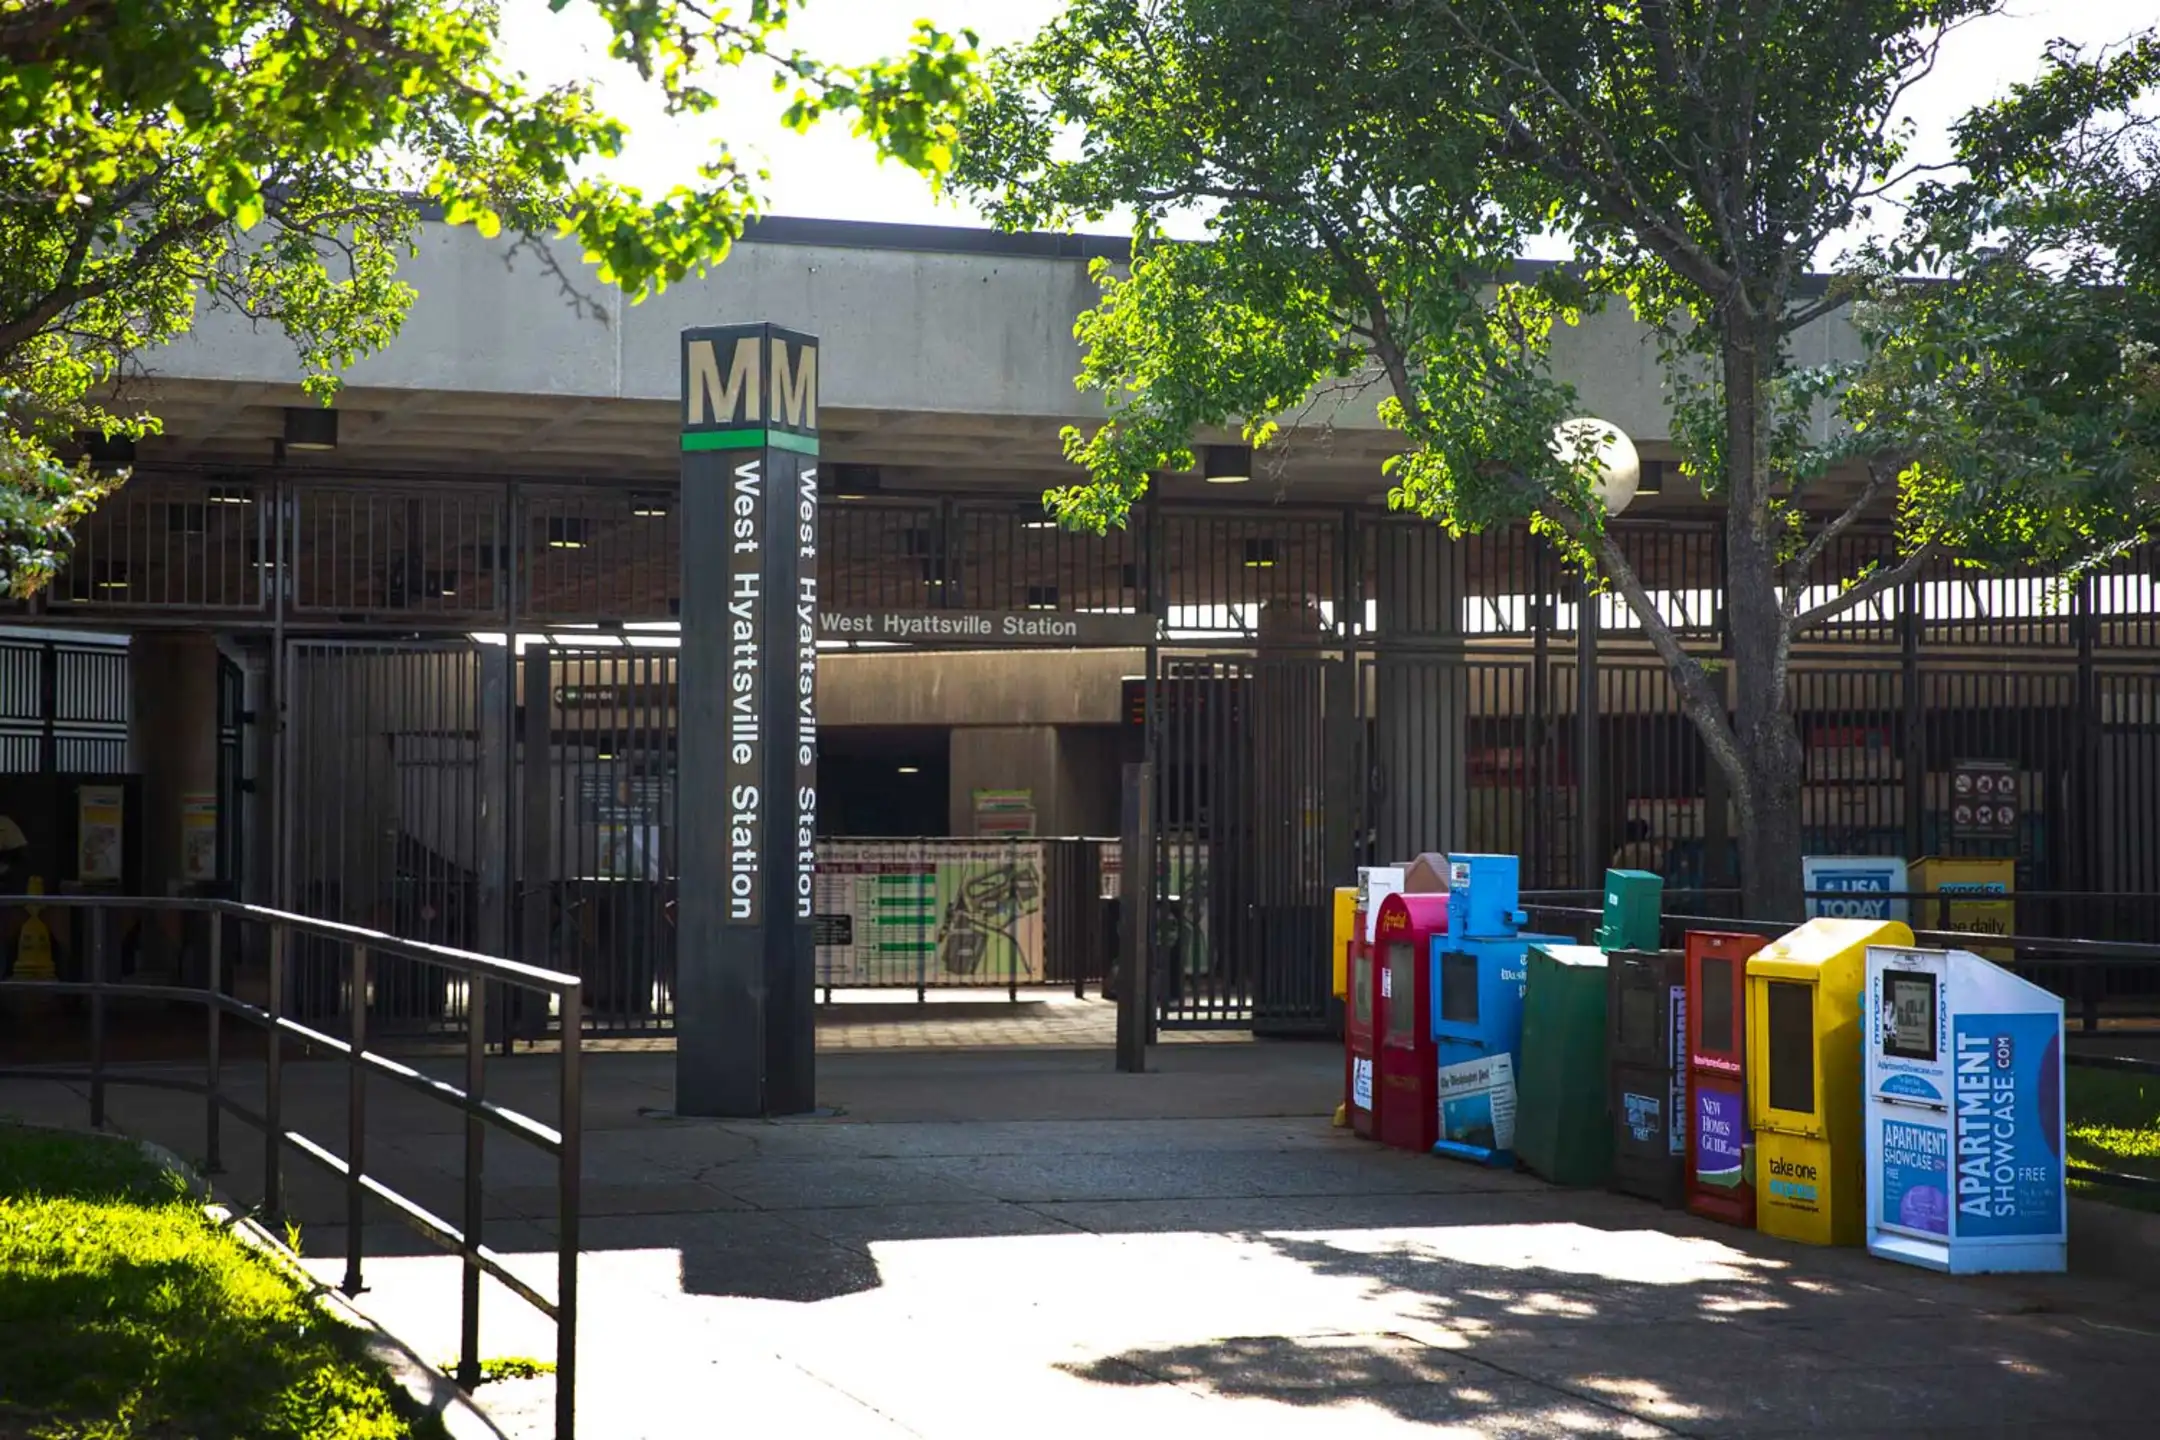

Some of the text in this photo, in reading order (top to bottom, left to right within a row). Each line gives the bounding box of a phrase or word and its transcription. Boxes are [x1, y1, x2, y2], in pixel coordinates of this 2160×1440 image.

[688, 337, 761, 425] M
[771, 339, 817, 430] M
[820, 613, 1077, 637] West Hyattsville Station
[731, 460, 761, 918] West Hyattsville Station
[796, 468, 818, 918] West Hyattsville Station
[1841, 879, 1882, 893] USA
[1821, 900, 1885, 918] TODAY
[1970, 916, 2005, 935] daily
[1884, 1123, 1947, 1156] APARTMENT
[1957, 1032, 1992, 1219] APARTMENT
[1769, 1157, 1817, 1181] take one
[2018, 1166, 2047, 1182] FREE
